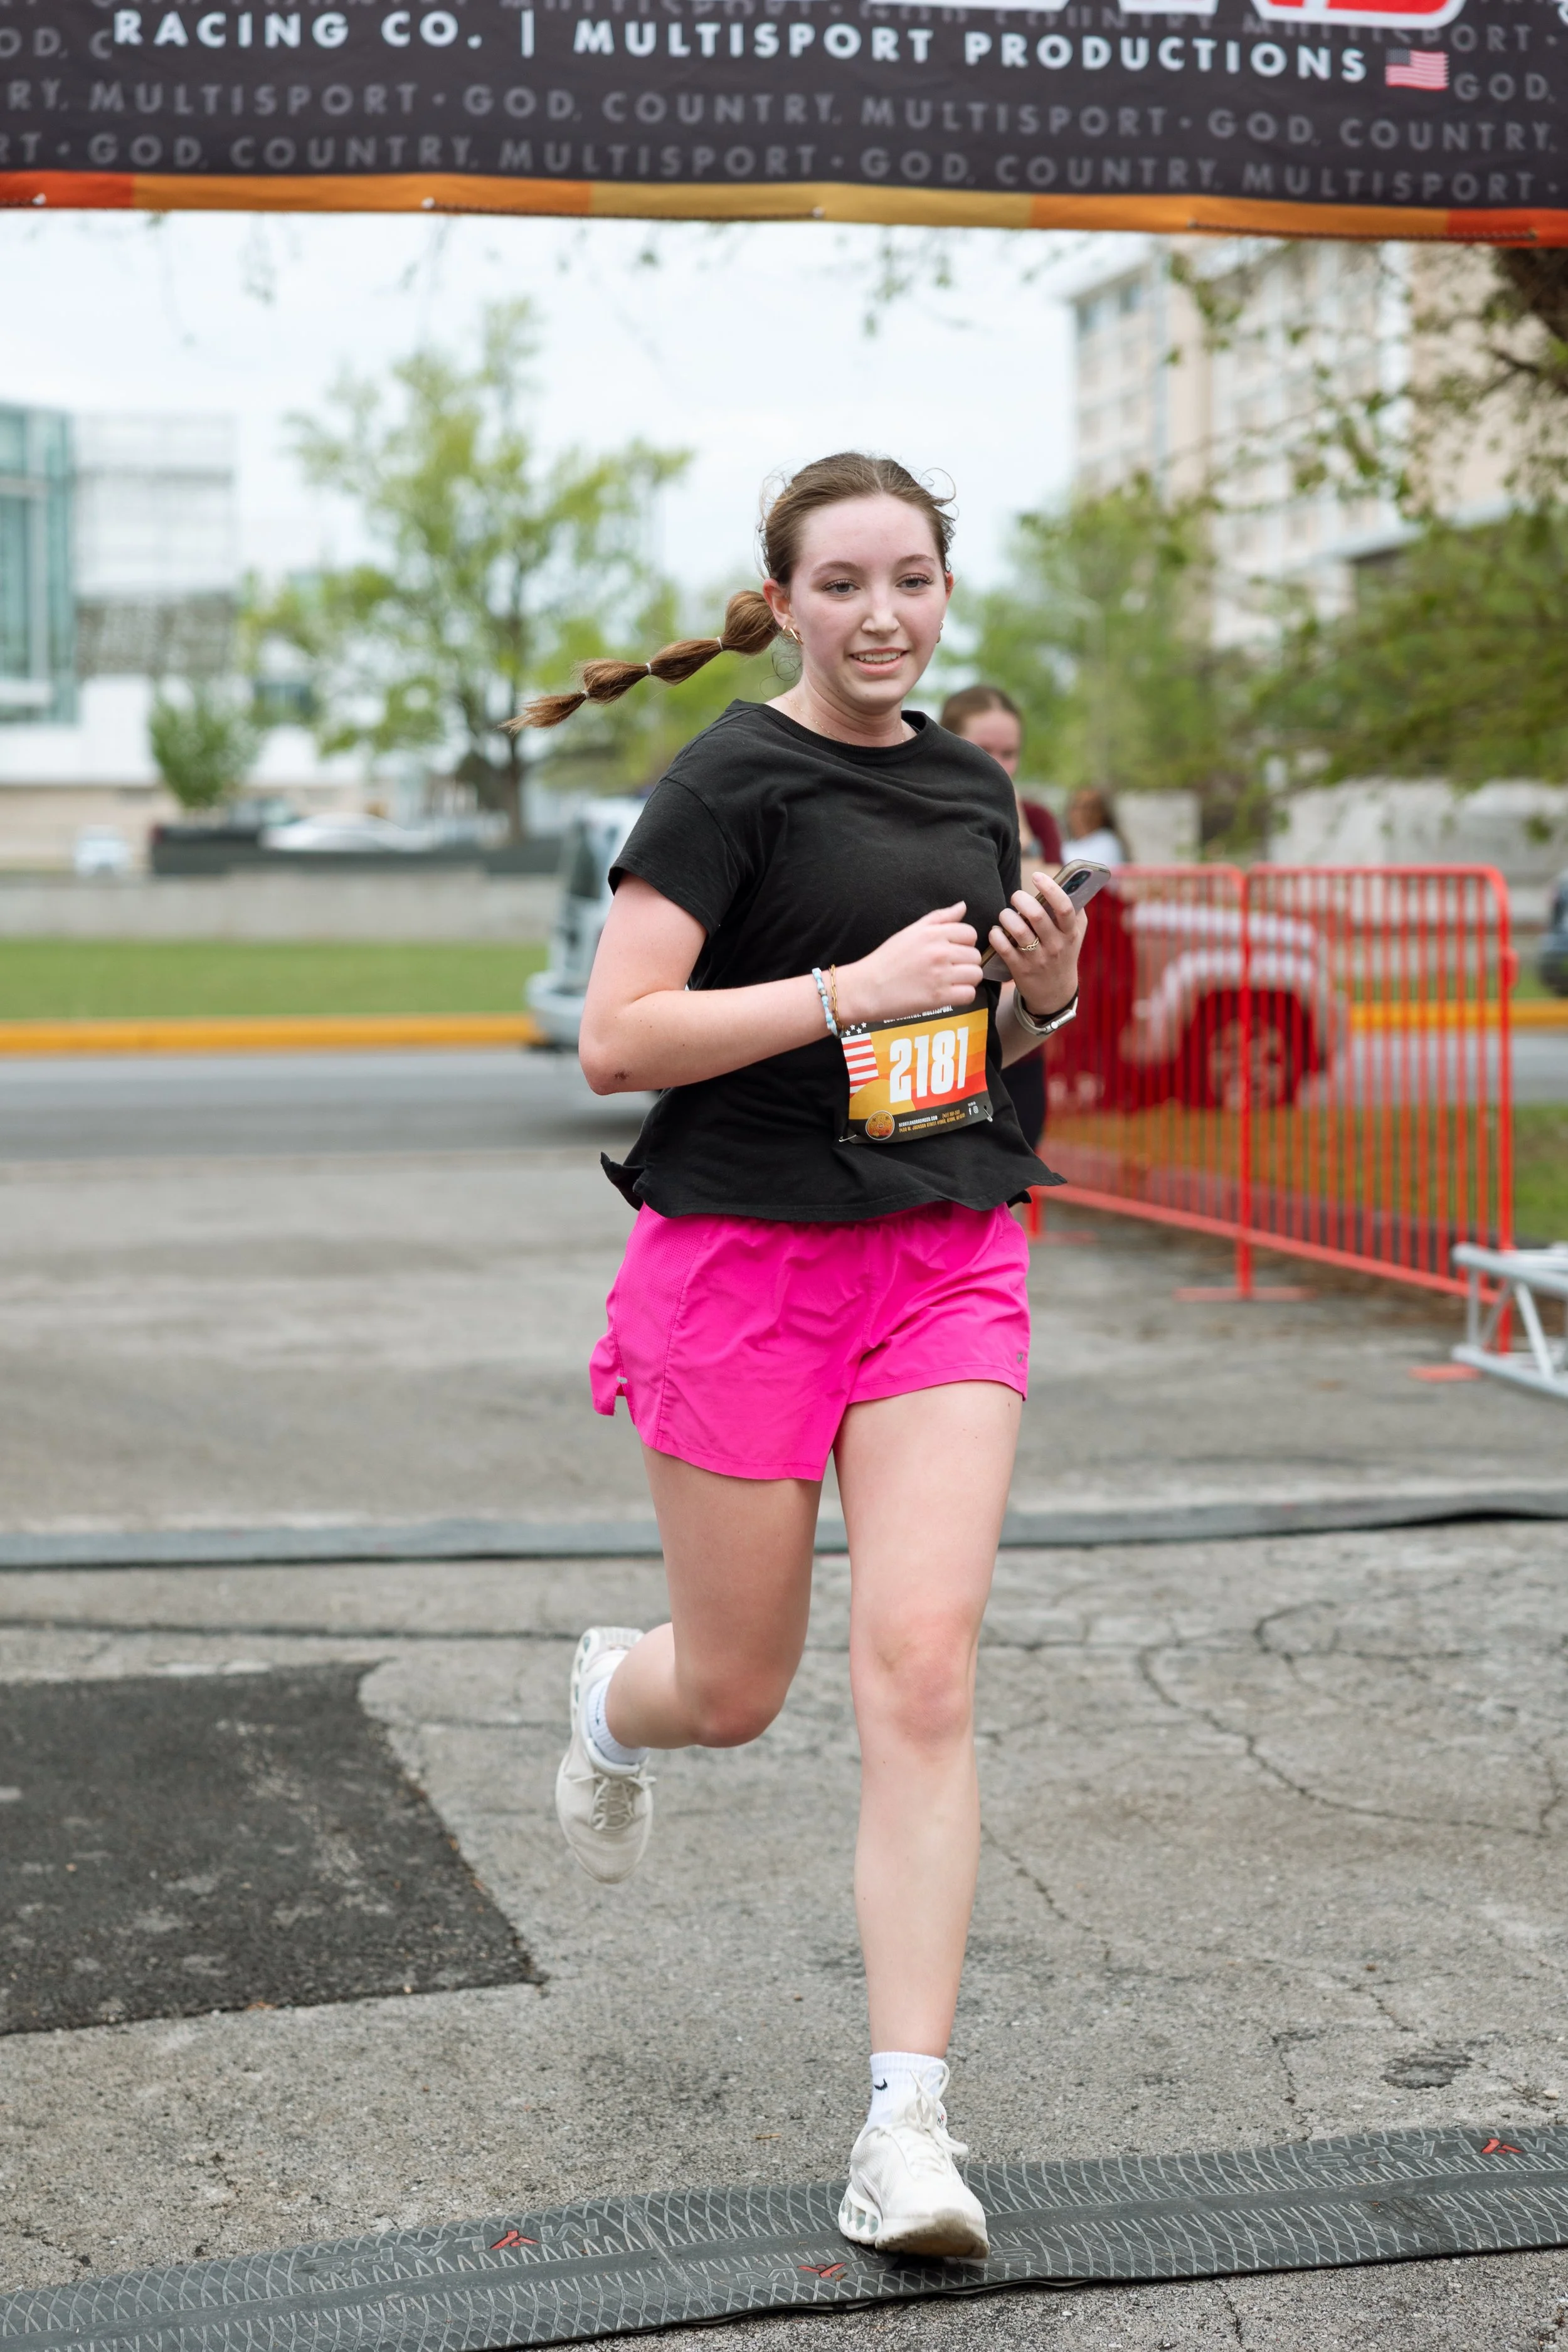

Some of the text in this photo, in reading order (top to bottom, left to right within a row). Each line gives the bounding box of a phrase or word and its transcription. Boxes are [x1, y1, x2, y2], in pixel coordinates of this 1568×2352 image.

[114, 8, 349, 49] RACING
[380, 9, 483, 50] CO.
[573, 18, 933, 65] MULTISPORT
[964, 31, 1367, 84] PRODUCTIONS
[90, 82, 416, 116] MULTISPORT
[861, 97, 1167, 137] MULTISPORT
[500, 140, 817, 177] MULTISPORT
[1244, 163, 1534, 200] MULTISPORT
[889, 1027, 969, 1104] 2181
